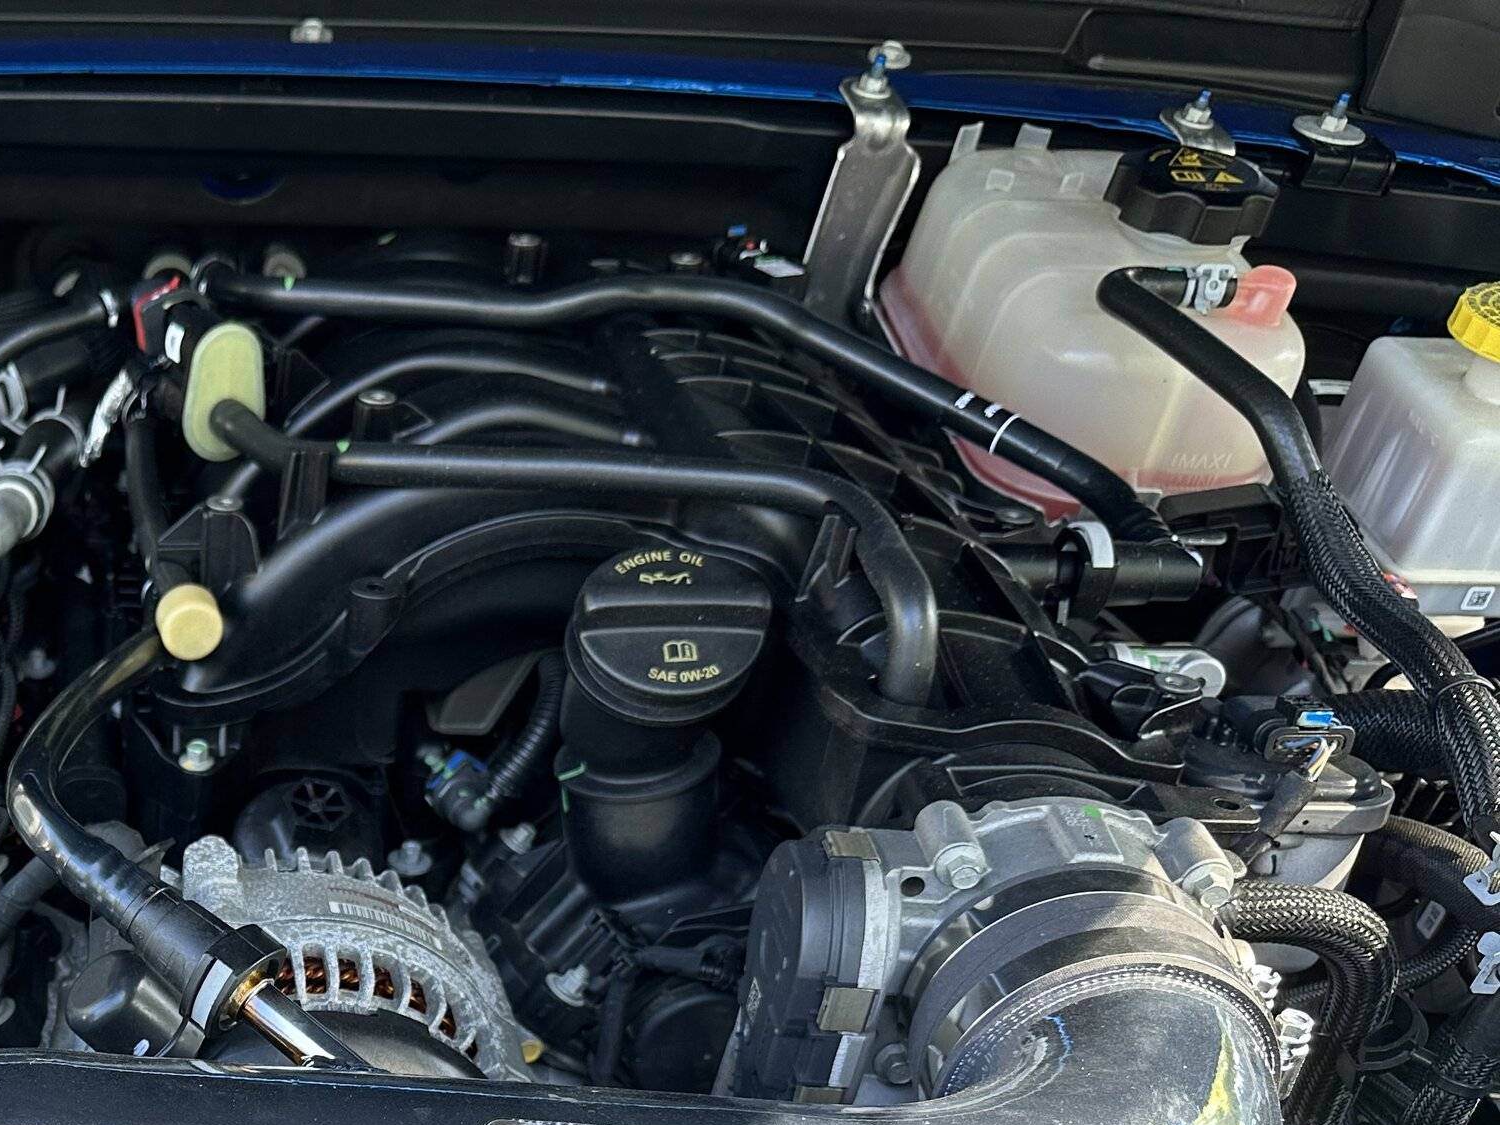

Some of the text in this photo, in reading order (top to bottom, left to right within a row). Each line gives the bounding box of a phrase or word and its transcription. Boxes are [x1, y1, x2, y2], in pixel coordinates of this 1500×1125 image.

[613, 551, 705, 575] ENGINE OIL
[648, 664, 720, 682] SAE 0W-20
